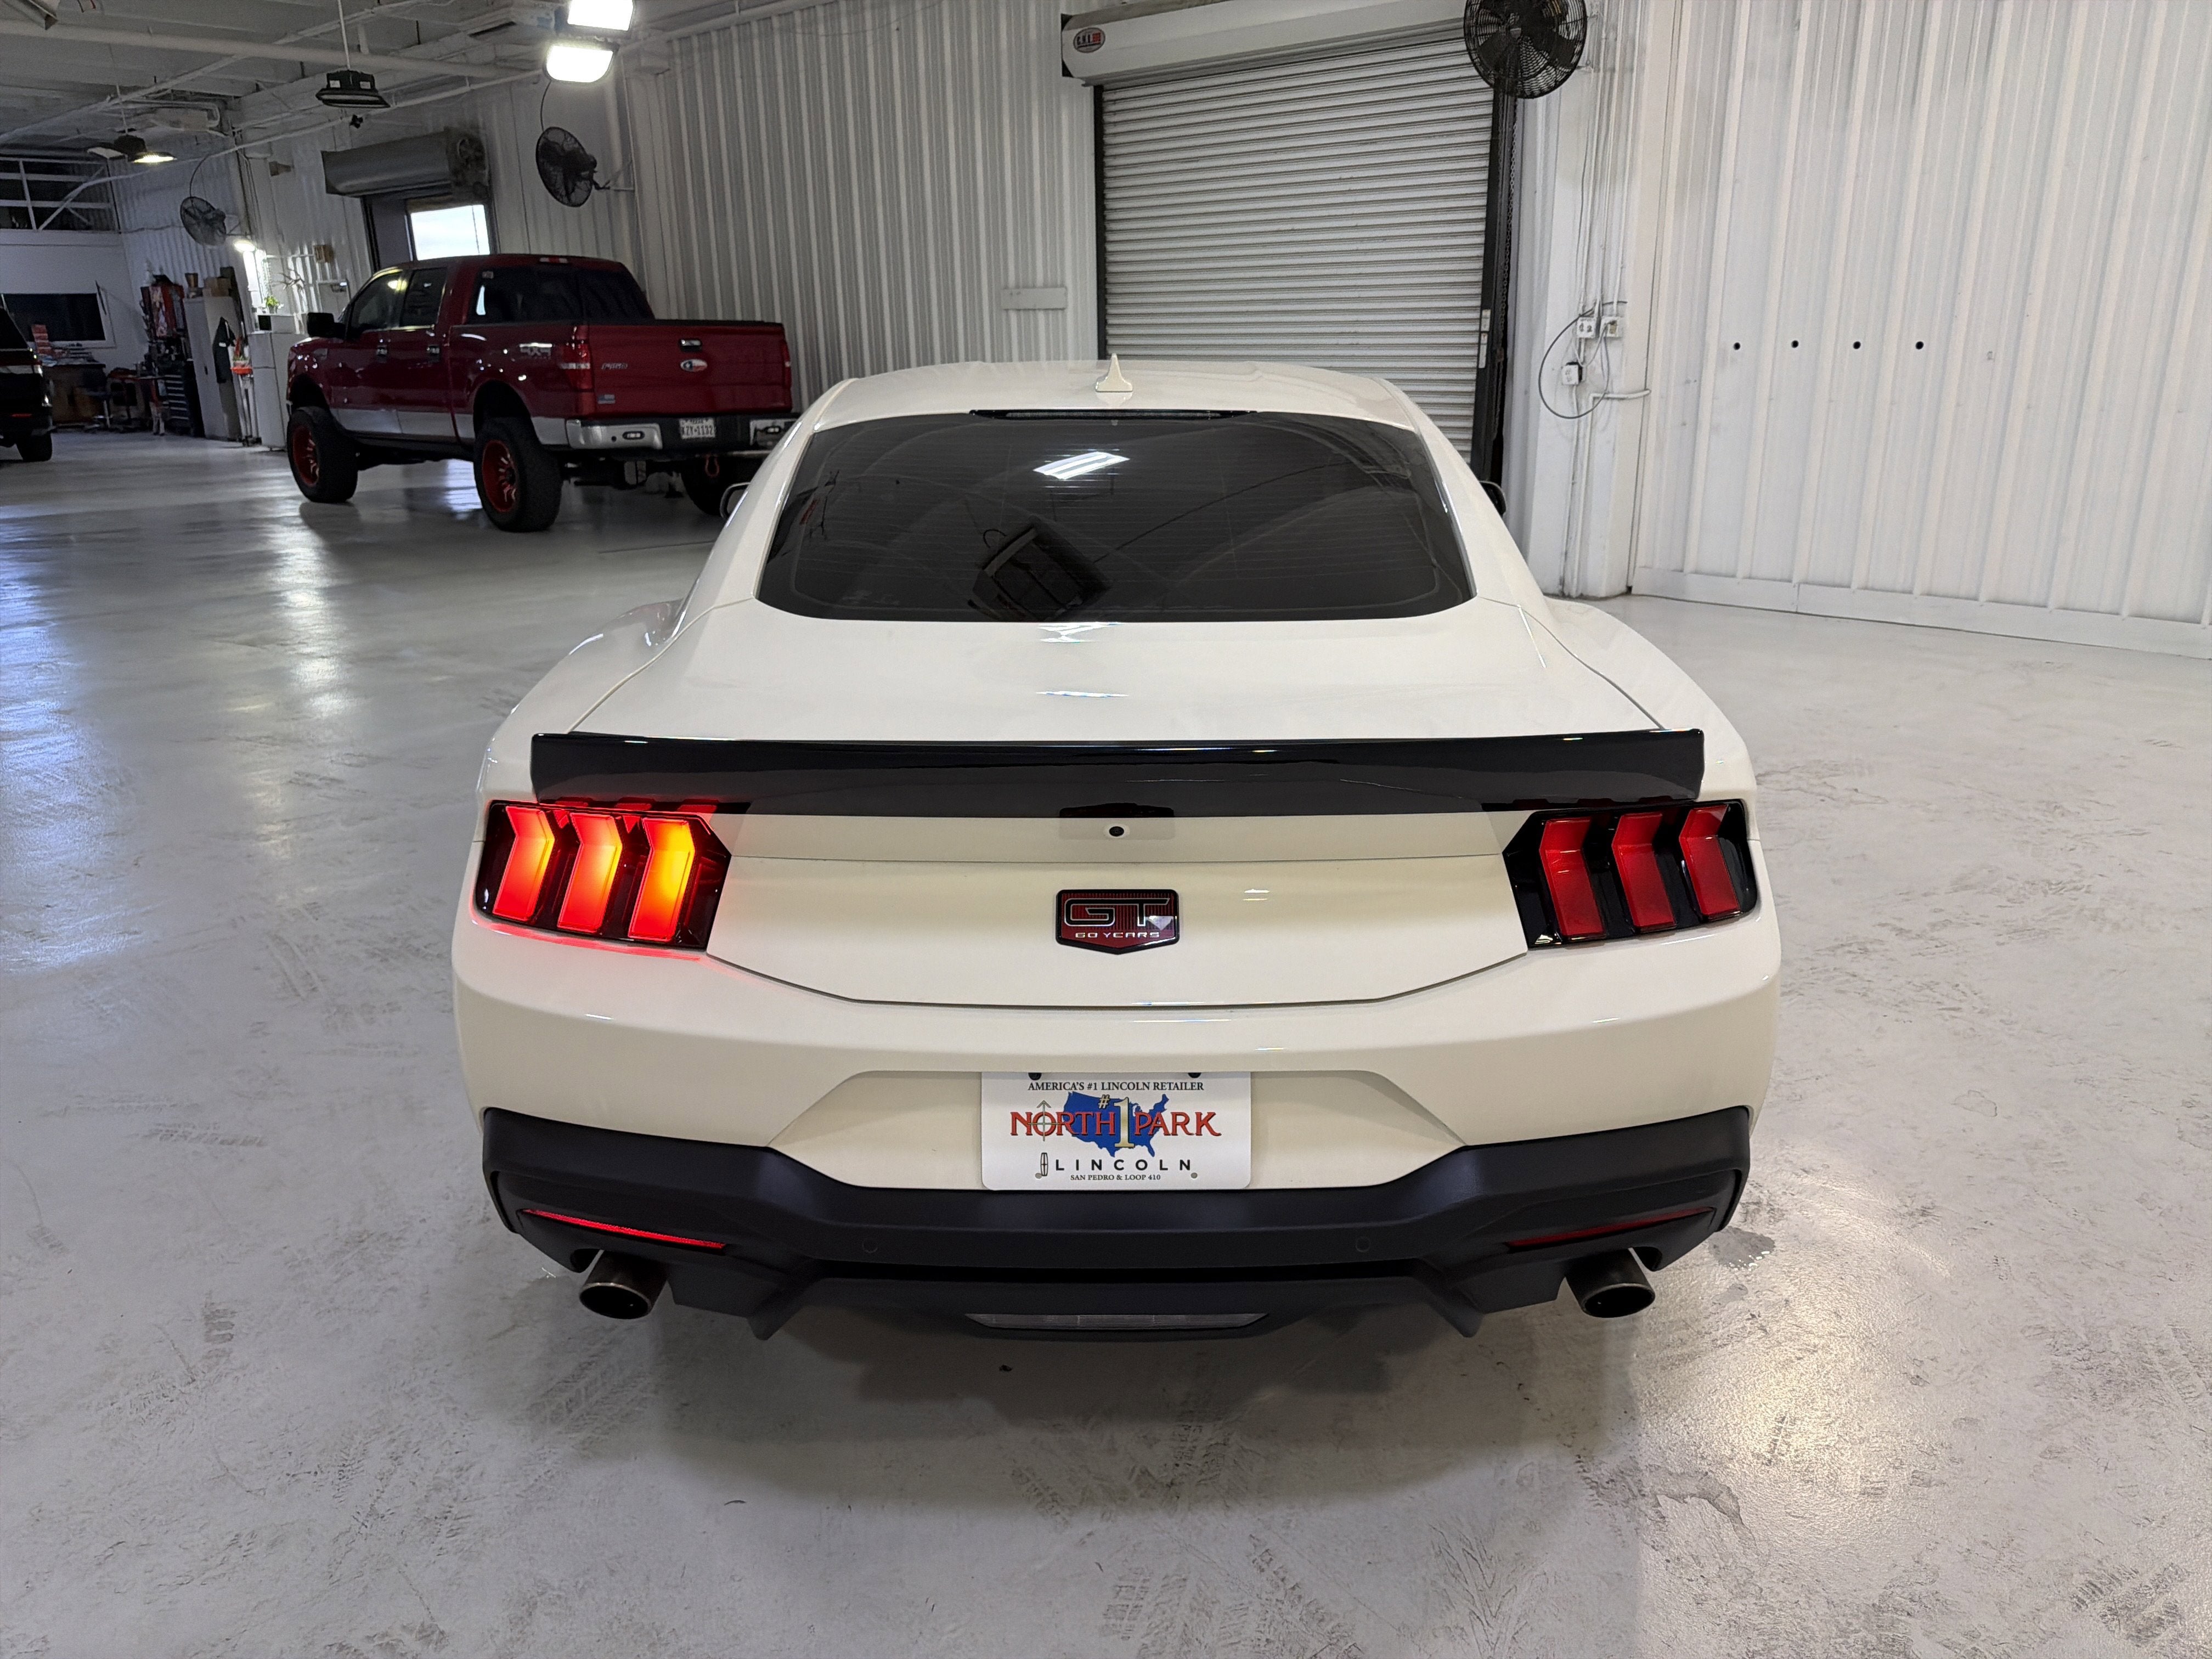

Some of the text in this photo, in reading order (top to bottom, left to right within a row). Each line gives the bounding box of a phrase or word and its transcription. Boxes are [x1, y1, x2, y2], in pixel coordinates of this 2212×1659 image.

[1064, 898, 1170, 927] GT
[1028, 1081, 1205, 1091] AMERICA'S #1 LINCOLN RETAILER
[1010, 1111, 1222, 1136] NORTH PARK
[1055, 1159, 1191, 1171] LINCOLN
